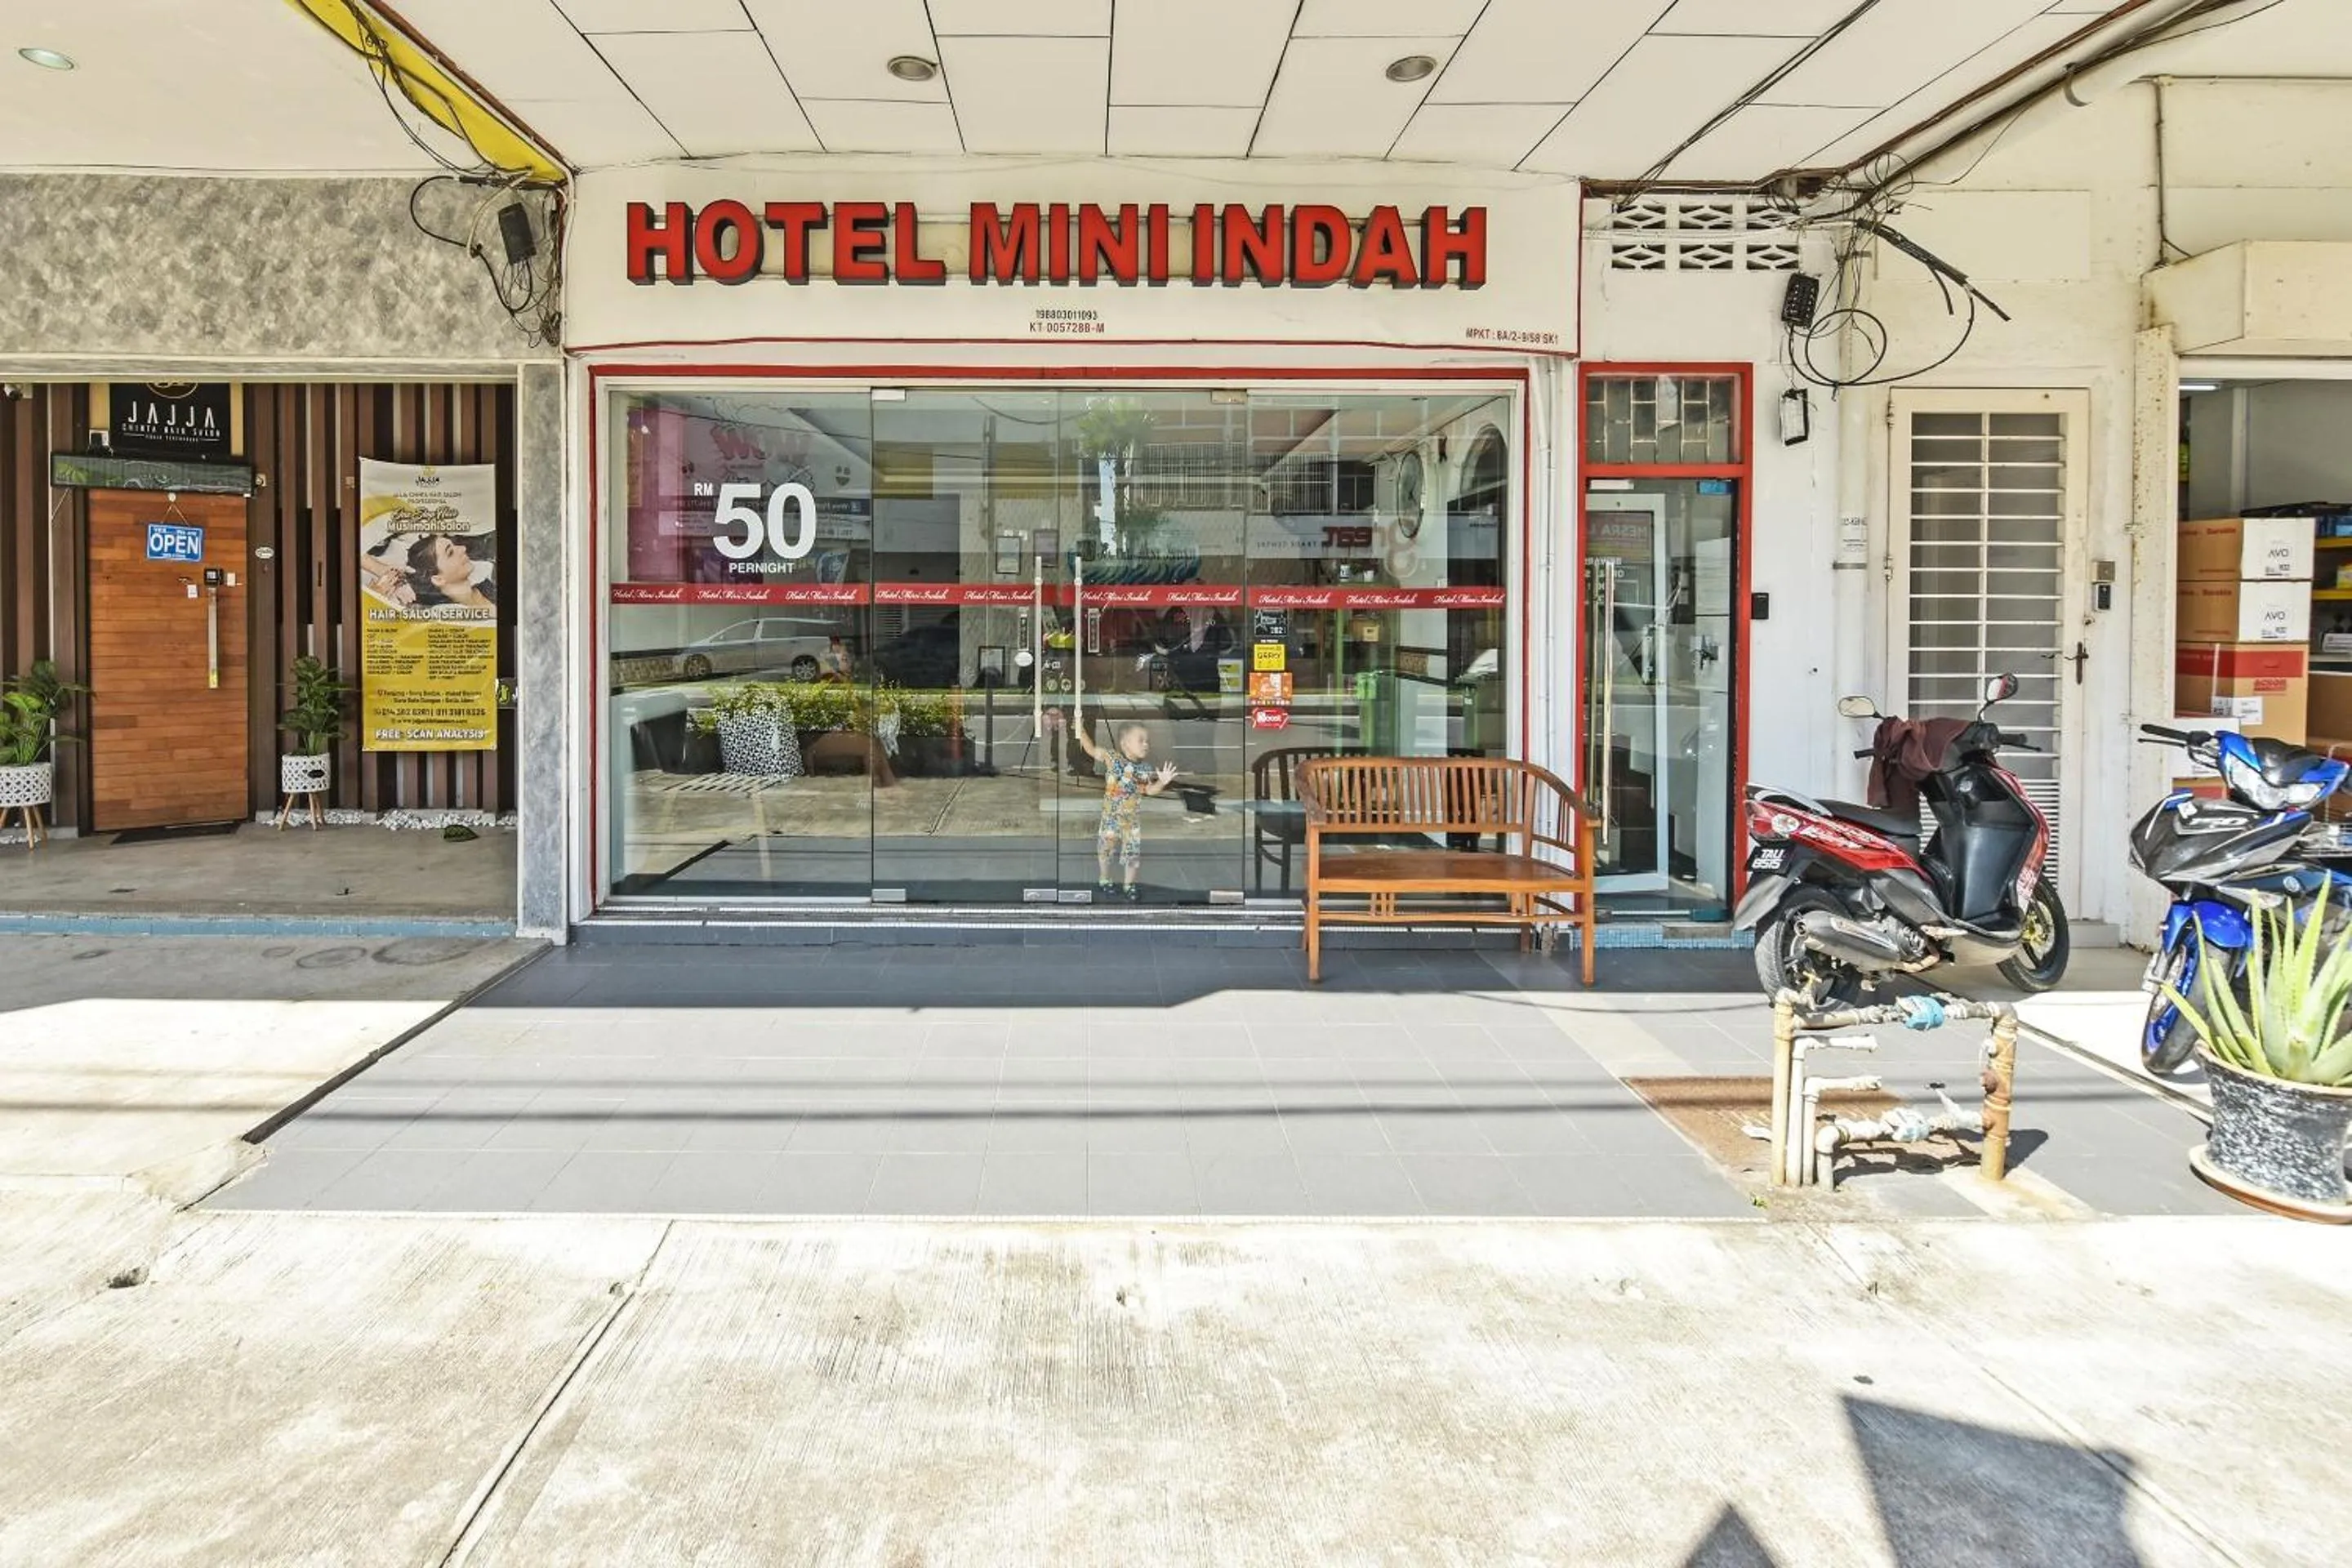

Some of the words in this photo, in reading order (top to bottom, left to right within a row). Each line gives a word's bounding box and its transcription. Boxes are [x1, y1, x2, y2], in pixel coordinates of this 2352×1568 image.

[627, 201, 947, 287] HOTEL
[969, 201, 1169, 287] MINI
[1192, 201, 1487, 291] INDAH
[1029, 323, 1044, 332] KT
[128, 400, 216, 429] JAJJA
[694, 483, 713, 496] RM
[713, 482, 817, 559] 50
[150, 533, 198, 555] OPEN
[728, 563, 795, 573] PERNIGHT
[612, 587, 631, 599] Hotel
[632, 587, 653, 599] Mini
[655, 587, 684, 599] Indah
[697, 589, 719, 600] Hotel
[719, 589, 741, 600] Mini
[742, 589, 771, 600] Indah
[786, 589, 808, 601] Hotel
[808, 589, 828, 601] Mini
[829, 589, 858, 601] Indah
[876, 589, 898, 600] Hotel
[898, 589, 920, 600] Mini
[921, 589, 949, 600] Indah
[964, 589, 986, 600] Hotel
[987, 589, 1008, 600] Mini
[1009, 589, 1036, 600] Indah
[1080, 590, 1100, 601] Hotel
[1102, 590, 1124, 601] Mini
[1125, 590, 1152, 601] Indah
[1166, 590, 1188, 601] Hotel
[1189, 590, 1209, 601] Mini
[1210, 590, 1239, 601] Indah
[1258, 591, 1282, 604] Hotel
[1282, 591, 1303, 604] Mini
[1303, 591, 1331, 604] Indah
[1347, 592, 1367, 604] Hotel
[1368, 592, 1389, 604] Mini
[1390, 592, 1417, 604] Indah
[1434, 592, 1455, 604] Hotel
[1455, 592, 1477, 604] Mini
[1477, 592, 1506, 604] Indah
[369, 608, 396, 620] HAIR
[403, 608, 439, 620] SALON
[441, 608, 490, 620] SERVICE
[376, 728, 401, 739] FREE
[408, 728, 434, 739] SCAN
[437, 728, 485, 739] ANALYSIS
[1761, 849, 1784, 858] TAU
